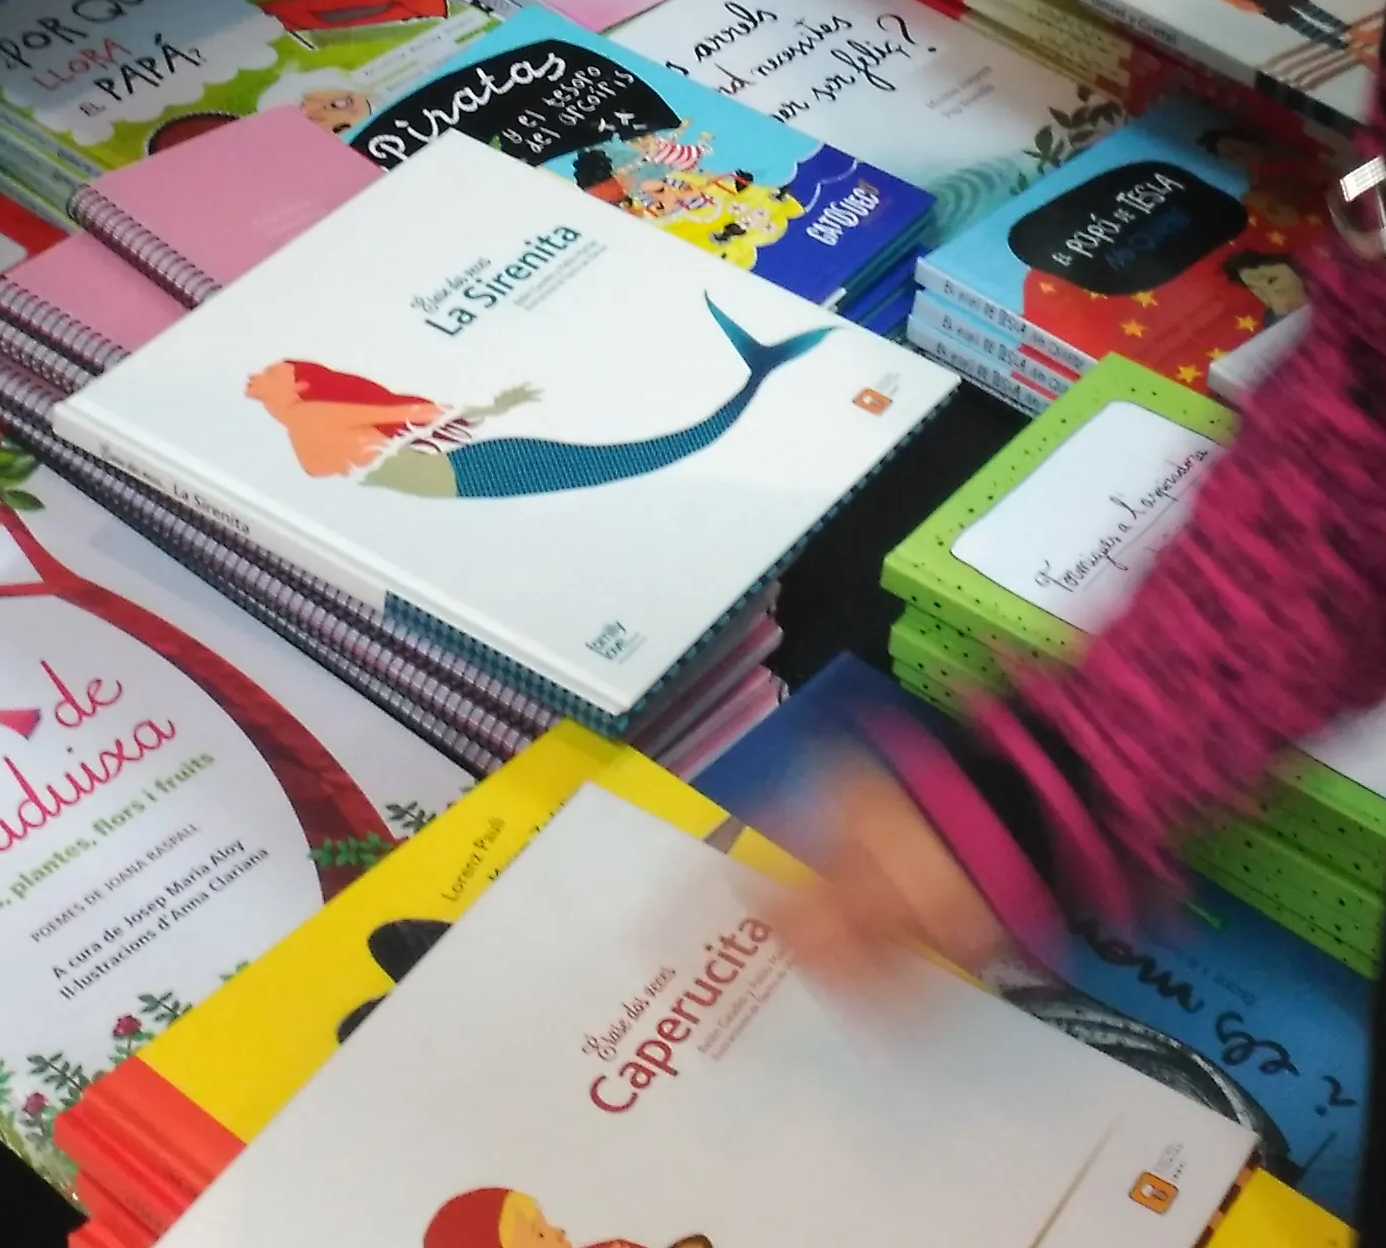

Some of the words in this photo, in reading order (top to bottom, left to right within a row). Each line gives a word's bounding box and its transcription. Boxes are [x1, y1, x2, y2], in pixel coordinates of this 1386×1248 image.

[32, 36, 133, 91] LLORA
[693, 0, 778, 63] arrels
[93, 32, 208, 102] PAPÁ?
[367, 52, 566, 162] Piratas
[517, 109, 547, 128] el
[524, 126, 562, 154] del
[1115, 171, 1186, 215] TESLA
[424, 306, 479, 337] La
[462, 223, 583, 309] Sirenita
[173, 483, 189, 501] La
[193, 493, 251, 535] Sirenita
[40, 659, 124, 729] de
[11, 834, 99, 901] plantes,
[91, 796, 148, 838] flors
[146, 787, 158, 805] i
[153, 750, 217, 795] fruits
[29, 902, 87, 945] POEMES
[84, 887, 105, 909] DE
[103, 855, 150, 895] JOANA
[144, 821, 203, 864] RASPALL
[51, 962, 67, 982] A
[66, 939, 105, 968] cura
[100, 922, 126, 948] de
[122, 890, 169, 933] Josep
[208, 838, 247, 876] Aloy
[156, 888, 211, 934] d'Anna
[207, 845, 272, 899] Clariana
[440, 850, 485, 902] Lorenz
[588, 914, 776, 1115] Caperucita
[1215, 1009, 1301, 1079] els
